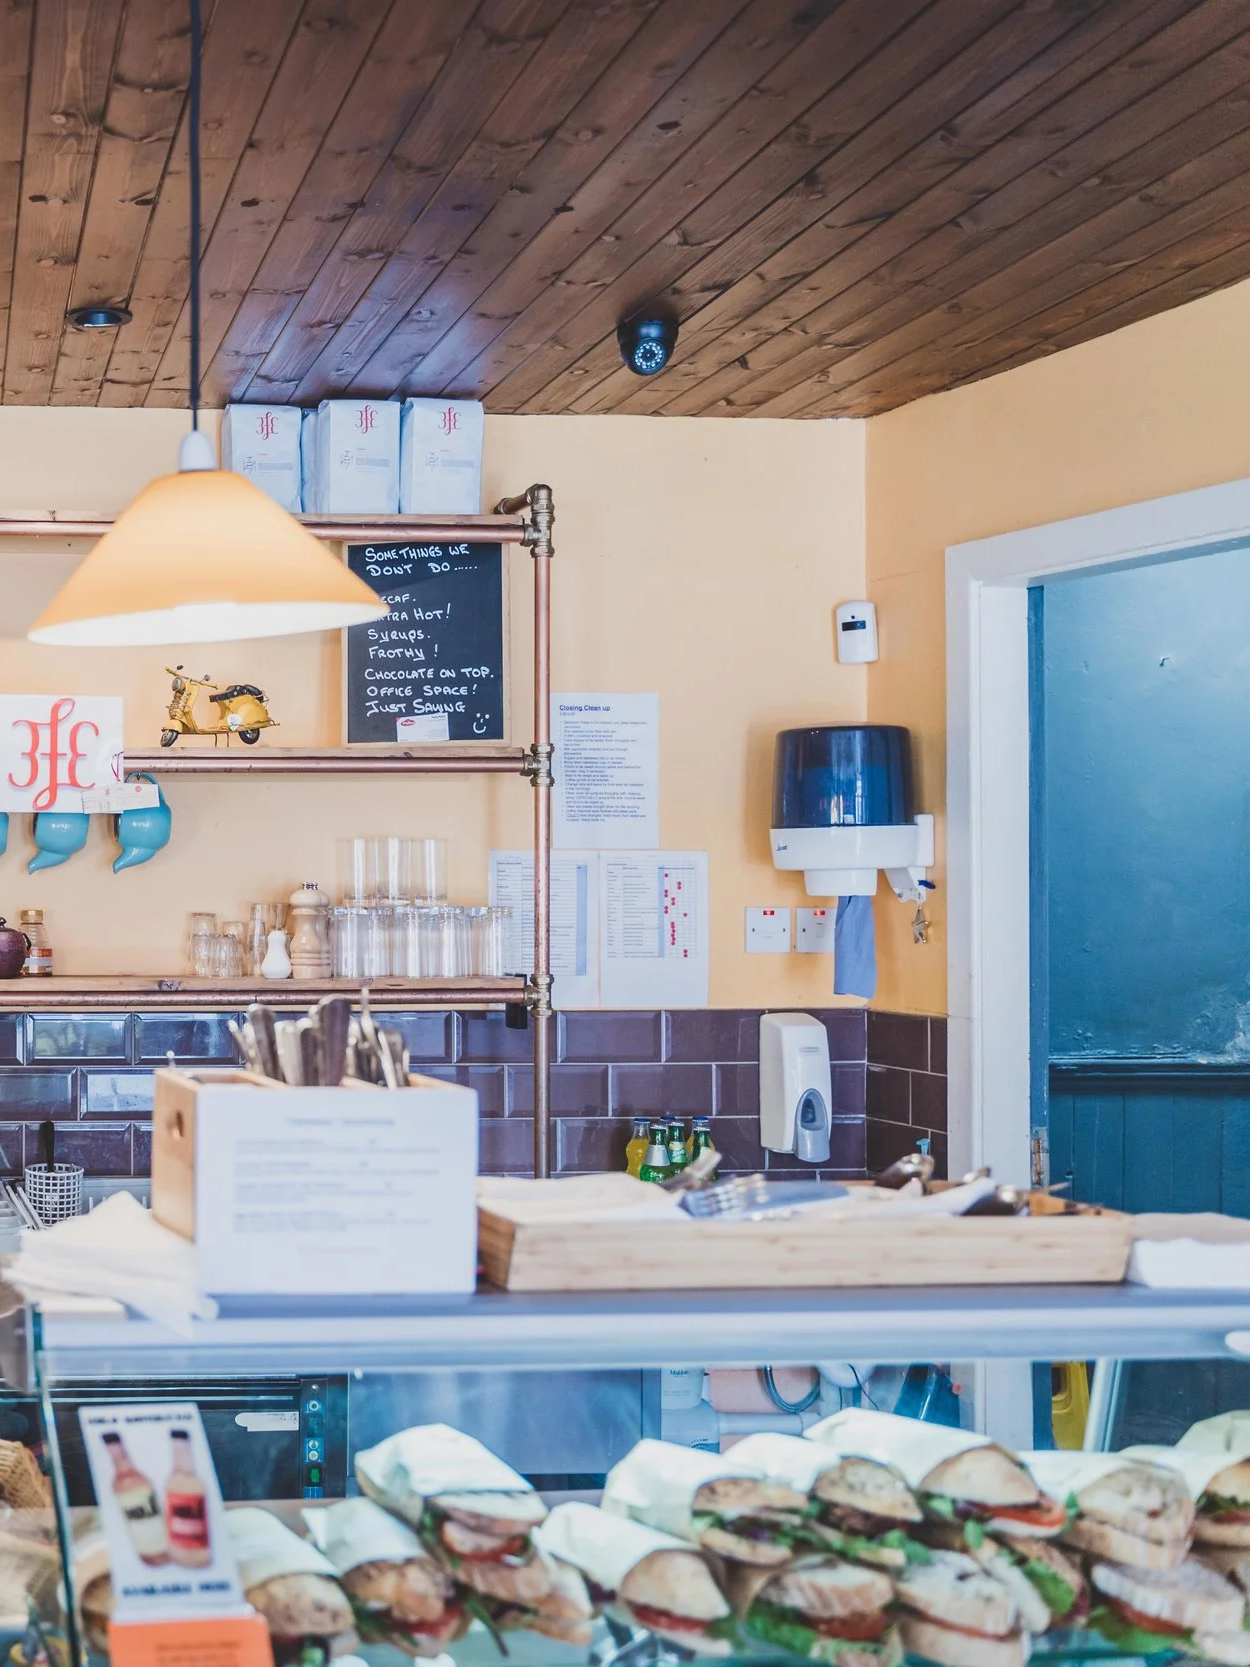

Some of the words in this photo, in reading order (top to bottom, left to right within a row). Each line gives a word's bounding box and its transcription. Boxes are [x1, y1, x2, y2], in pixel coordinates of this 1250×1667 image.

[449, 544, 470, 555] WE
[366, 563, 413, 577] DON'T
[381, 593, 416, 604] ECAF.
[413, 602, 451, 620] HOT!
[364, 668, 434, 680] CHOCOLATE
[439, 669, 456, 678] ON
[366, 686, 413, 697] OFFICE
[423, 684, 478, 696] SPACE!
[365, 700, 407, 717] JUST
[413, 699, 466, 714] SAYING
